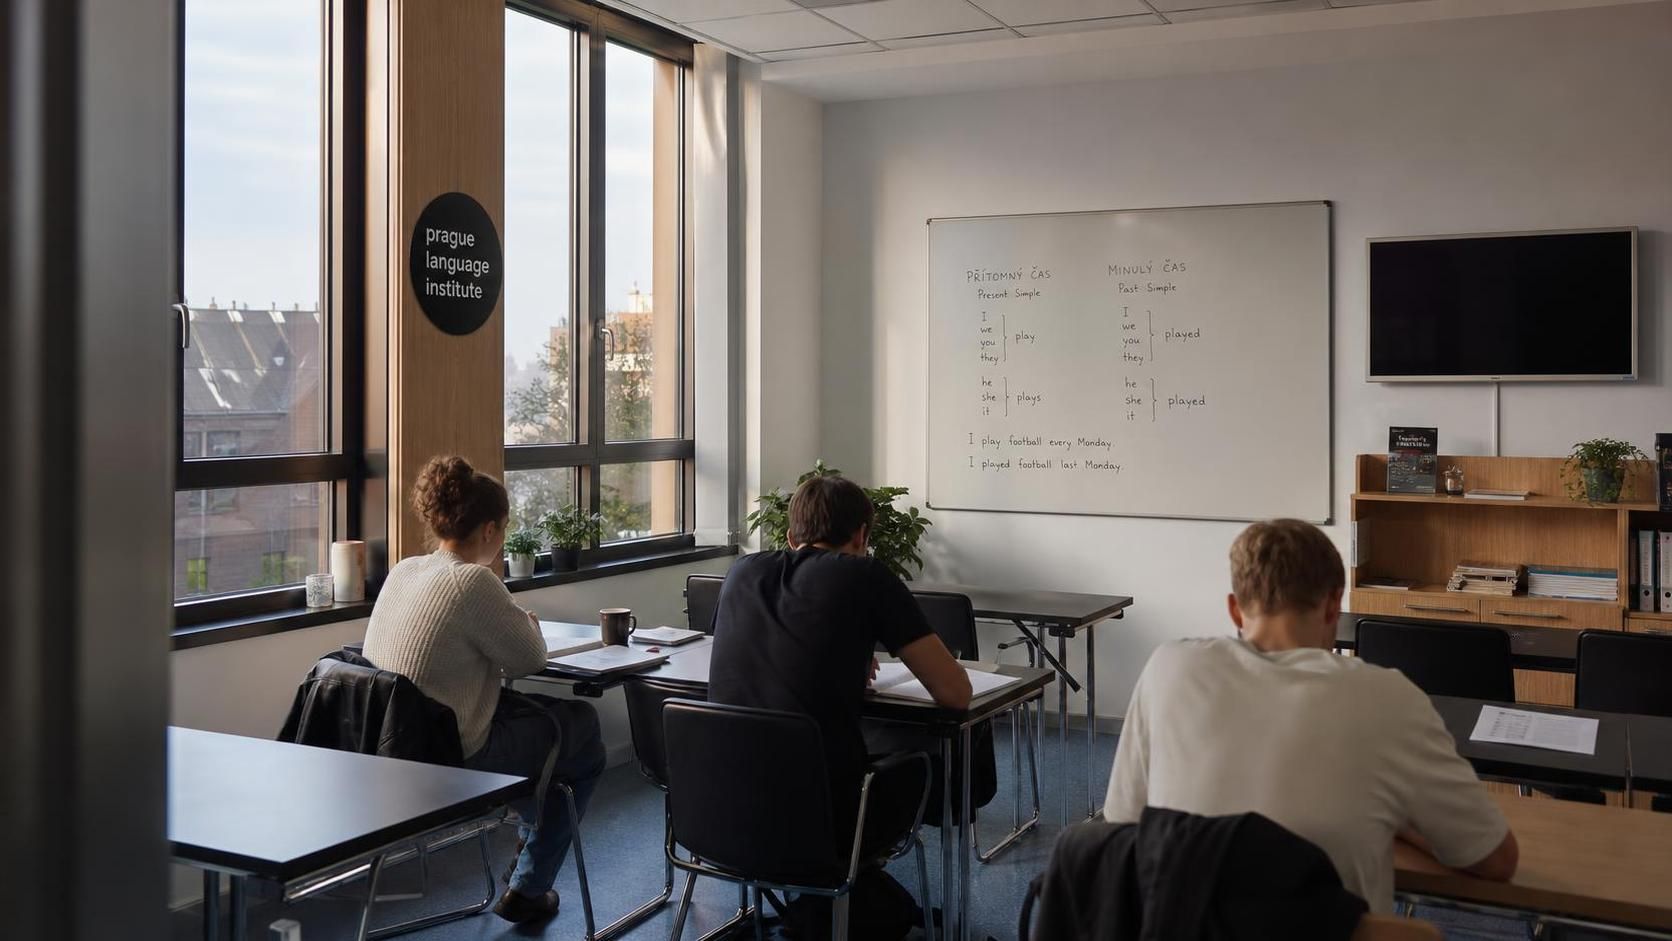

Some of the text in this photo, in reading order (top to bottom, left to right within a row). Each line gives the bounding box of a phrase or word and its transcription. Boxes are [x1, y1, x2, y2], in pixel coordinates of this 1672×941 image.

[426, 227, 475, 249] prague
[426, 251, 490, 277] language
[1108, 259, 1187, 276] MINULÝ ČAS
[966, 265, 1052, 283] PŘÍTOMNÝ ČAS
[426, 277, 483, 299] institute
[977, 288, 1041, 300] Present Simple
[1118, 282, 1177, 294] Past Simple
[981, 311, 988, 322] I
[1122, 307, 1129, 318] I
[1122, 323, 1137, 331] we
[1015, 330, 1036, 344] play
[1165, 328, 1201, 341] played
[980, 339, 996, 350] you
[1122, 337, 1141, 349] you
[980, 352, 1000, 366] they
[1122, 353, 1144, 366] they
[981, 376, 993, 387] he
[1125, 377, 1137, 389] he
[981, 392, 997, 402] she
[1017, 391, 1042, 406] plays
[1125, 395, 1142, 406] she
[1168, 396, 1206, 410] played
[982, 406, 990, 416] it
[1126, 410, 1136, 421] it
[968, 433, 975, 445] I
[981, 437, 1001, 450] play
[1009, 433, 1042, 447] football
[1049, 440, 1072, 451] every
[968, 456, 975, 468] I
[982, 459, 1010, 472] played
[1018, 458, 1052, 470] football
[1060, 459, 1078, 469] last
